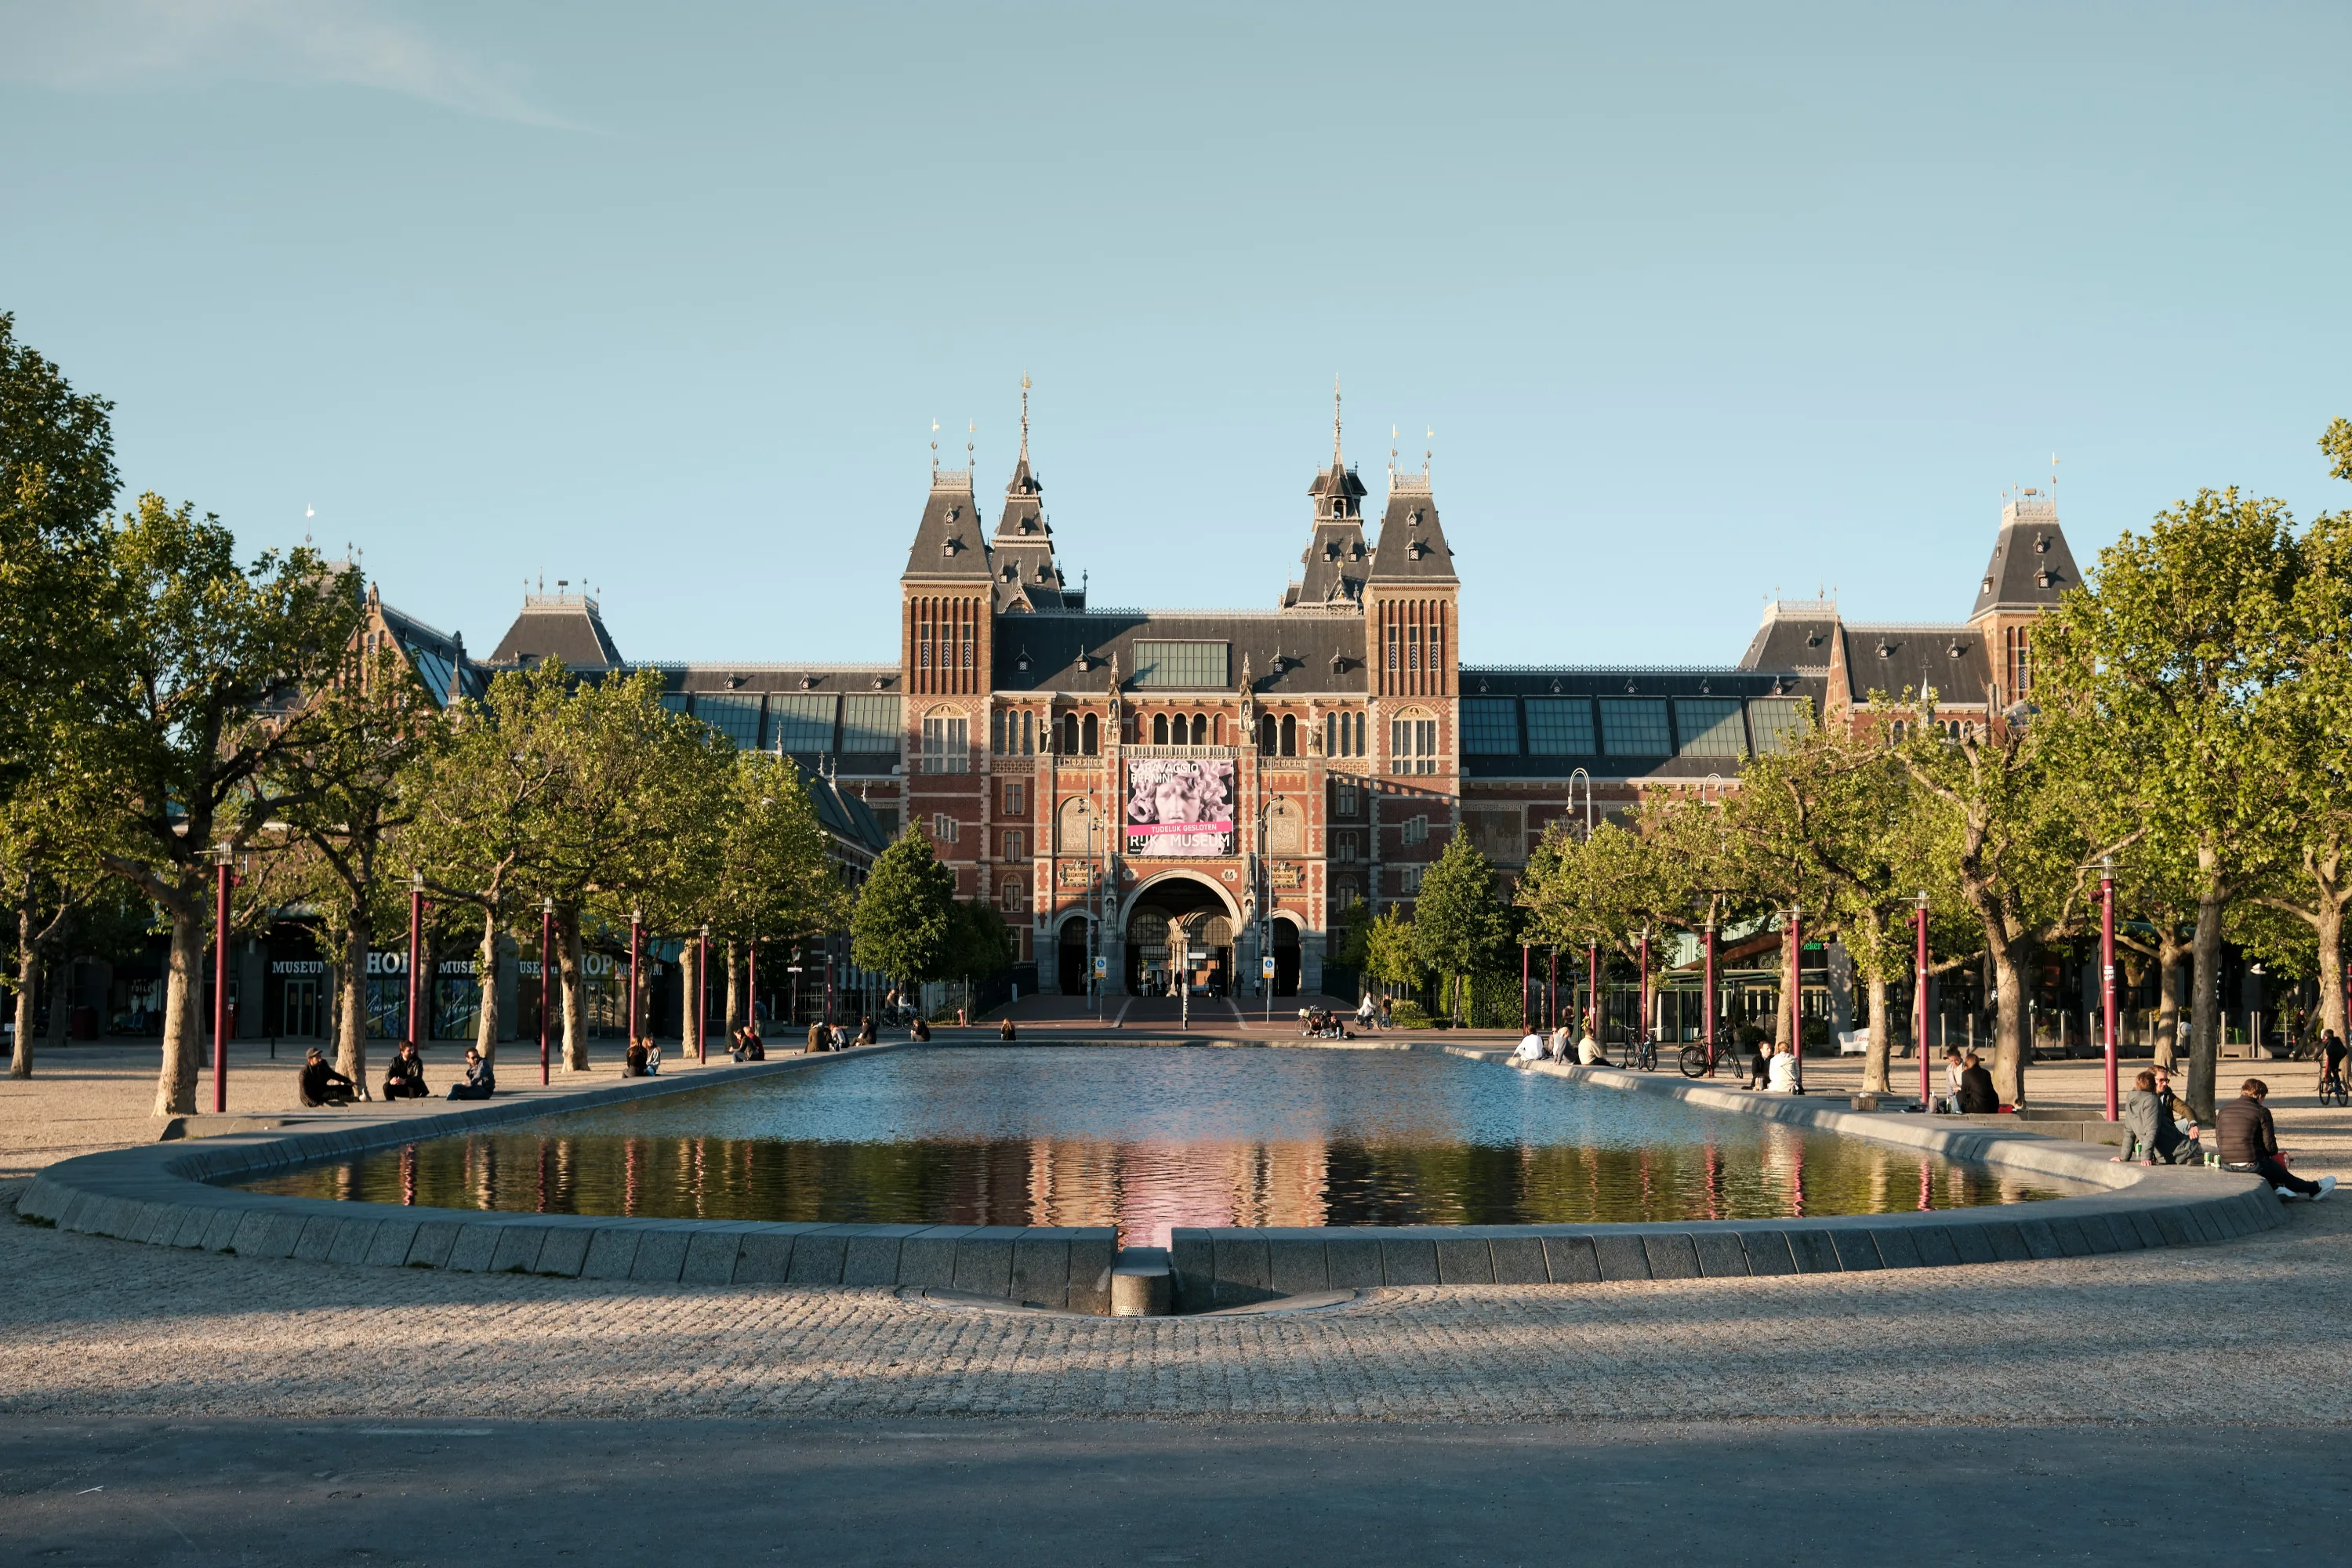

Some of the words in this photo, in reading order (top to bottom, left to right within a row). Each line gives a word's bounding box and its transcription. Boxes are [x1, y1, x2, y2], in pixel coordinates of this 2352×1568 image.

[1131, 763, 1199, 773] CARAVAGGIO
[1131, 773, 1173, 783] BERNINI
[1171, 833, 1230, 847] MUSEUM
[1803, 940, 1823, 950] eken
[366, 952, 408, 974] HO
[438, 960, 477, 974] MUSE
[581, 953, 613, 975] OP
